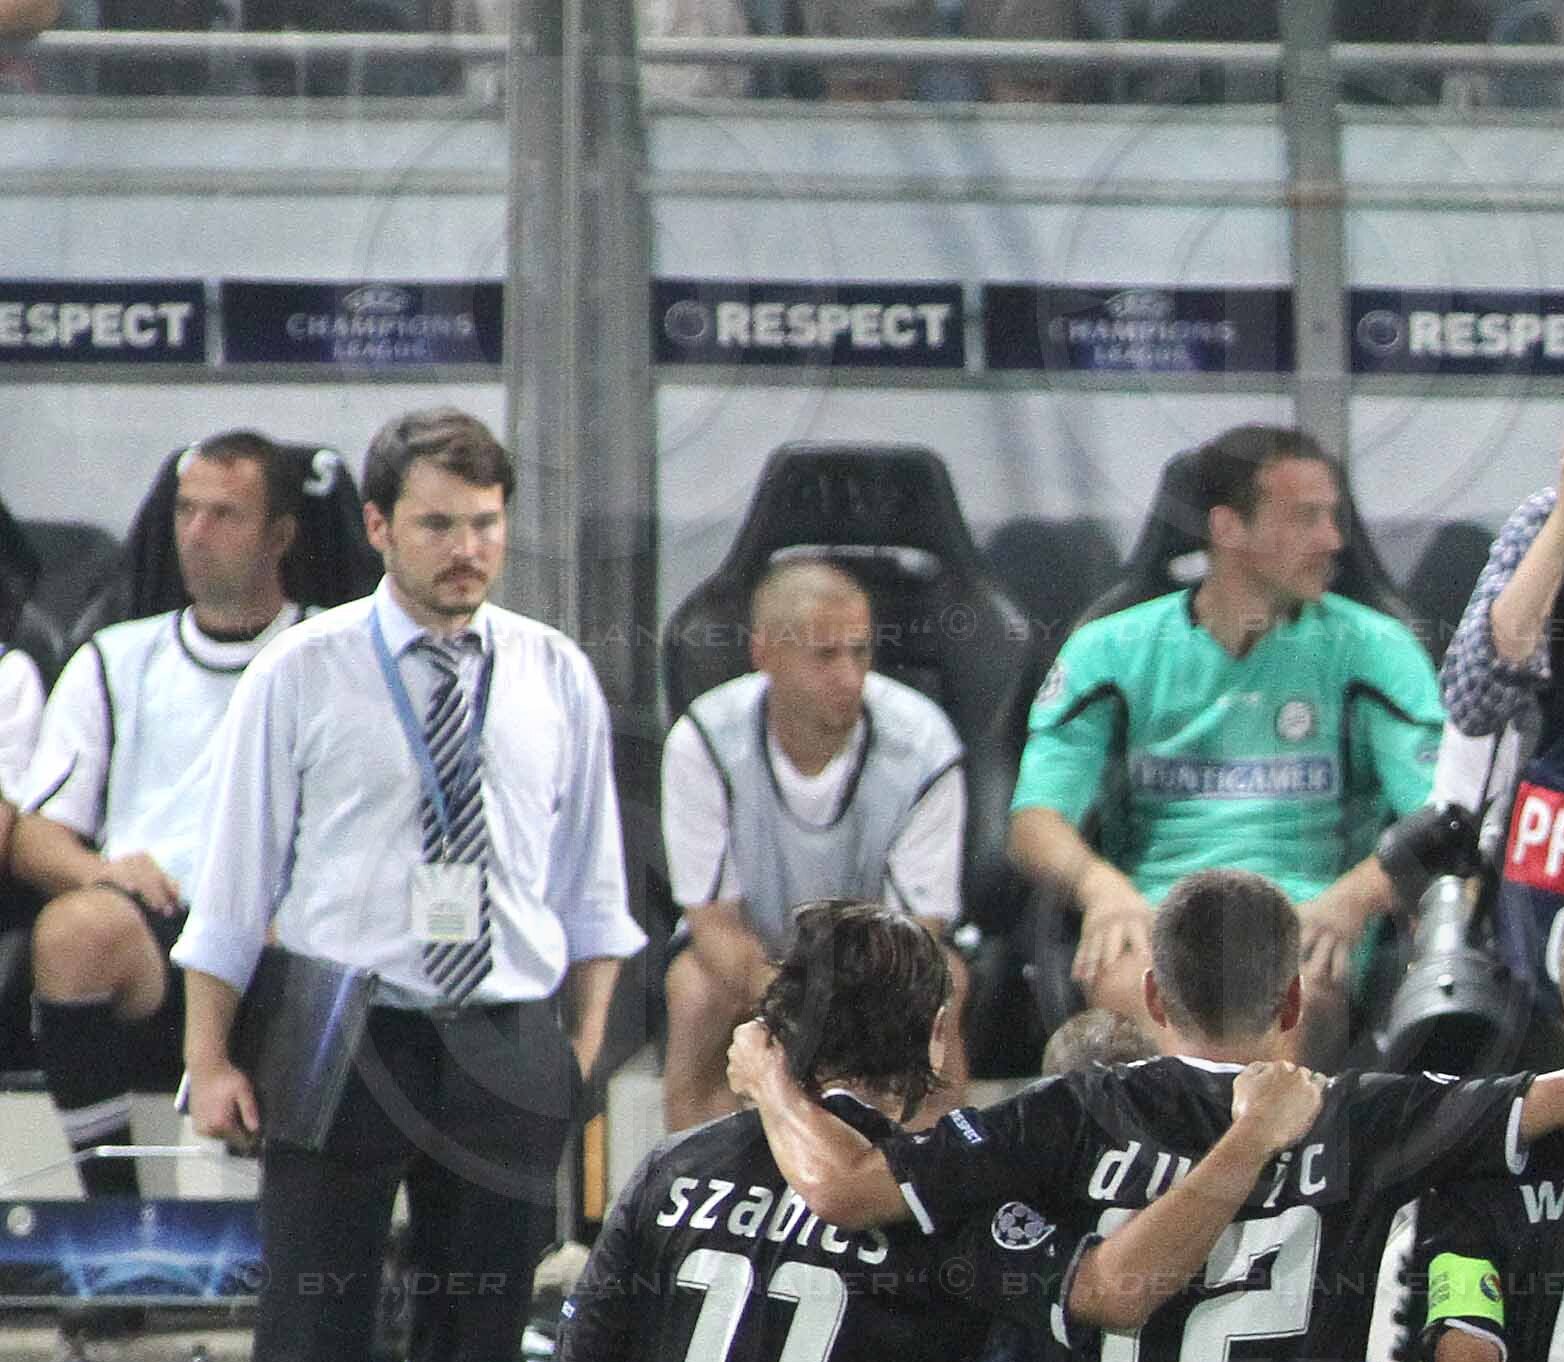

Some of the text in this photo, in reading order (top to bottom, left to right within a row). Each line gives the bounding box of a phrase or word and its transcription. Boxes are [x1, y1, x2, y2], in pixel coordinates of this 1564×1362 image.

[0, 303, 191, 347] ESPECT
[716, 303, 950, 348] RESPECT
[1088, 1140, 1328, 1209] duic
